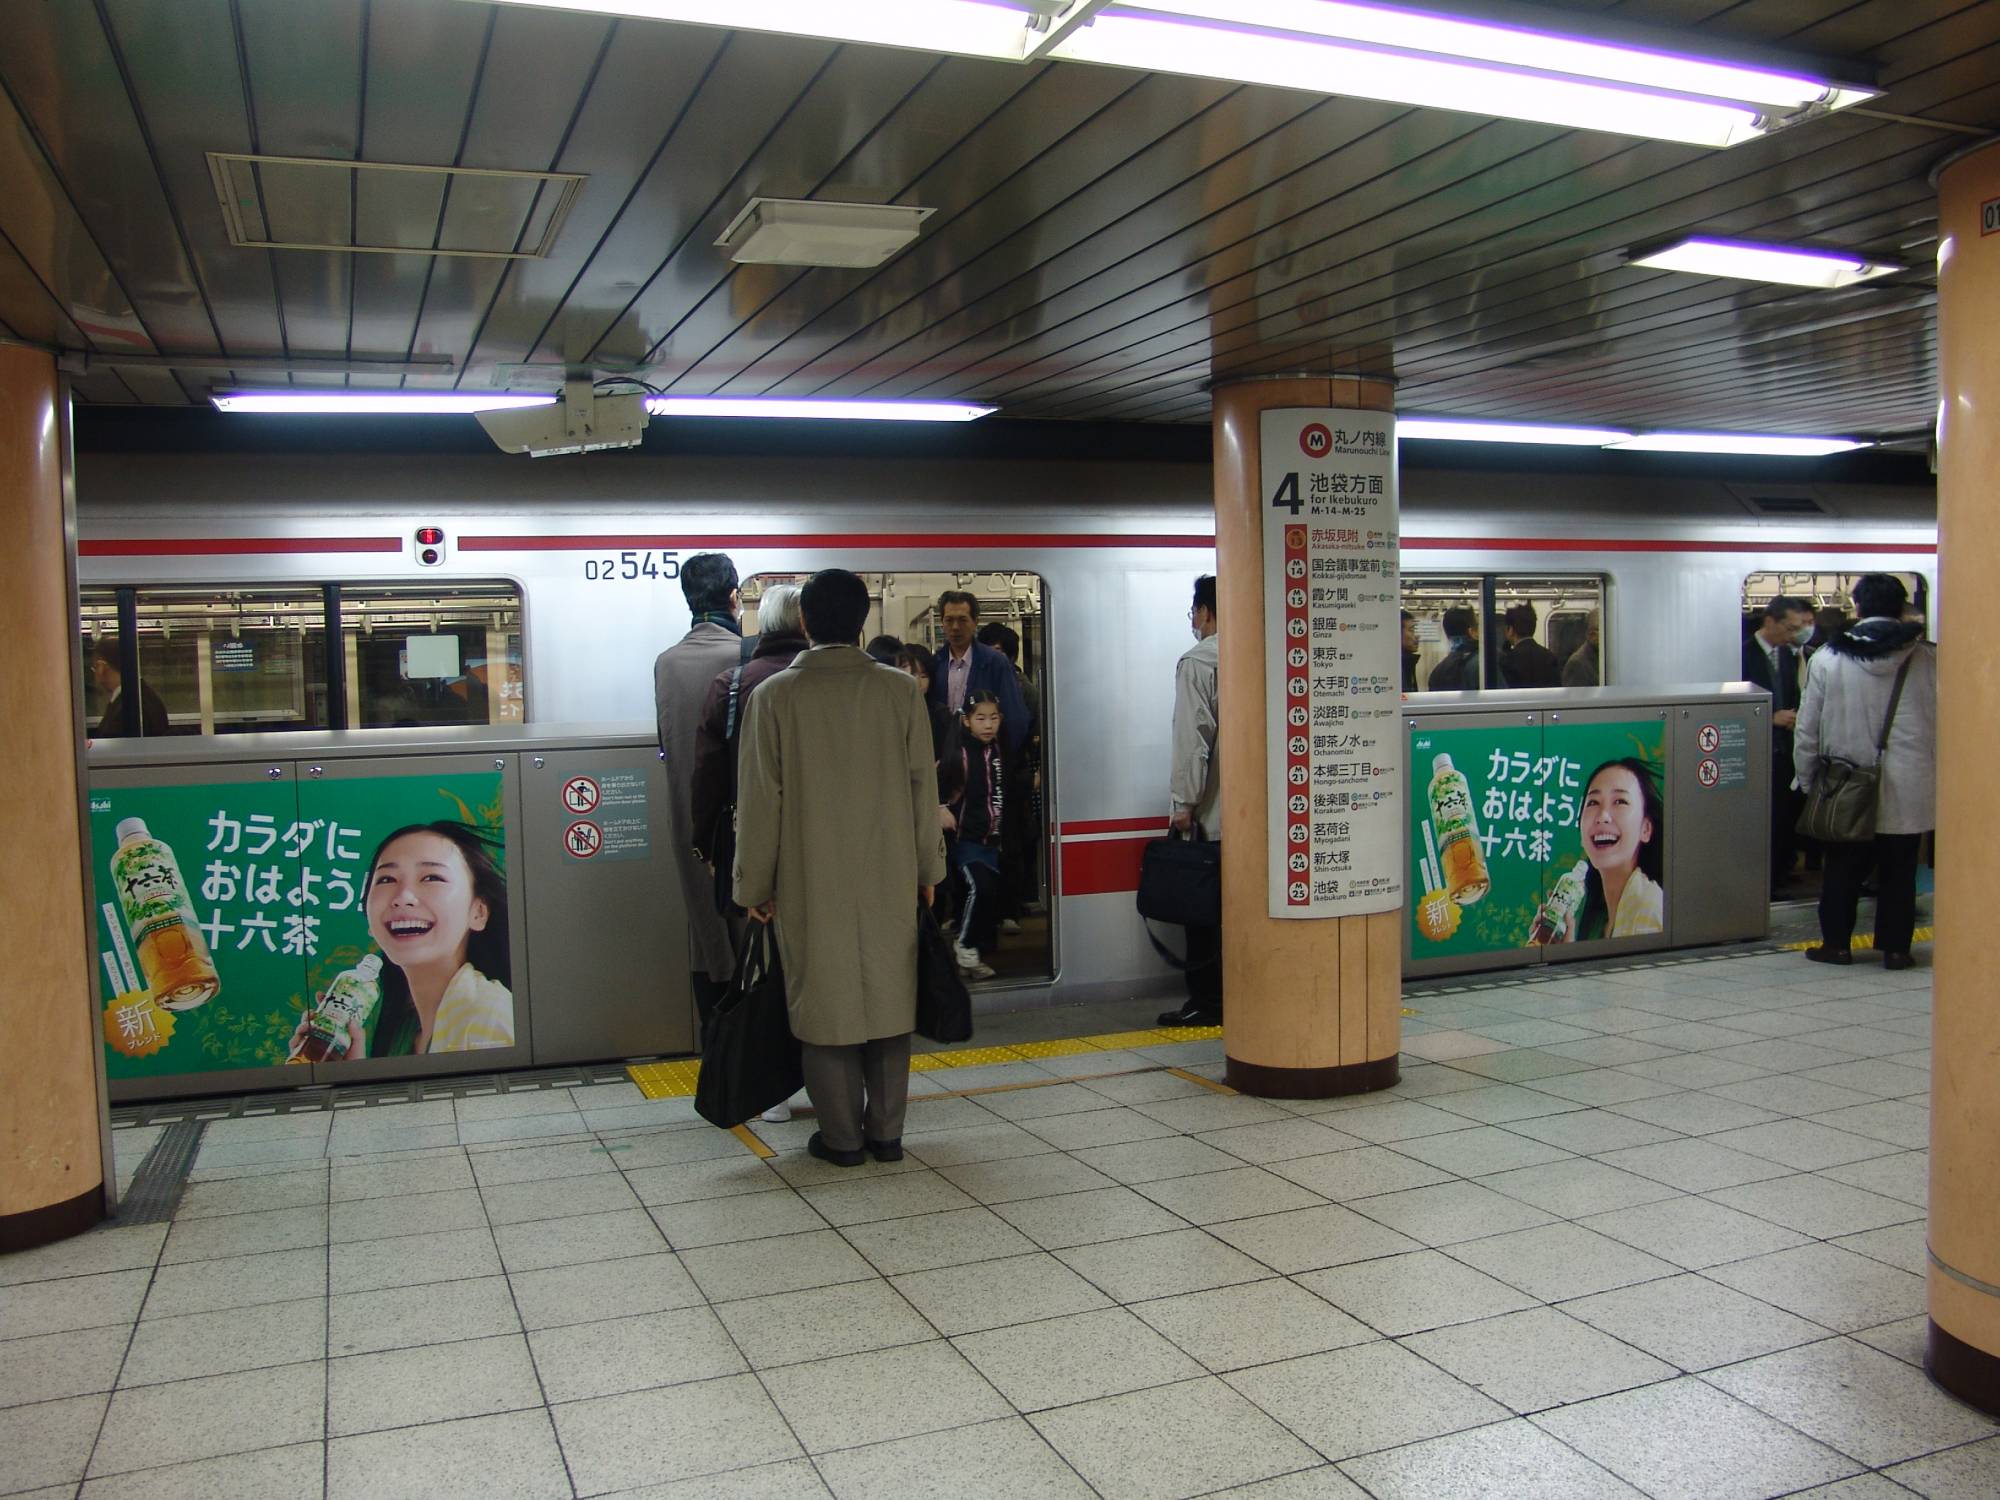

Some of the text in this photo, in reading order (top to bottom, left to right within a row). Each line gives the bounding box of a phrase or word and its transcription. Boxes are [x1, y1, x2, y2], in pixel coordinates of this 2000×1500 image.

[1309, 434, 1324, 447] M
[1335, 429, 1386, 447] 丸ノ内線
[1335, 447, 1390, 457] Marunouchi Line
[1310, 473, 1383, 494] 池袋方面
[1272, 472, 1304, 515] 4
[1311, 495, 1378, 506] for Ikebukuro
[1312, 528, 1359, 543] 赤坂見附
[1312, 543, 1365, 551] Akasaka-mitsuke
[1312, 558, 1380, 572] 国会議事堂前
[1291, 567, 1303, 575] 14
[1312, 573, 1367, 581] Kokkai-gijidomae
[1291, 597, 1303, 605] 15
[1312, 602, 1356, 610] Kasumigaseki
[1312, 617, 1337, 631] 銀座
[1291, 627, 1304, 635] 16
[1313, 647, 1338, 660] 東京
[1292, 656, 1304, 664] 17
[1313, 661, 1333, 669] Tokyo
[1313, 676, 1349, 690] 大手町
[1292, 686, 1304, 694] 18
[1313, 690, 1345, 698] Otemachi
[1313, 705, 1349, 719] 淡路町
[1292, 715, 1305, 723] 19
[1313, 720, 1344, 728] Awajicho
[1313, 734, 1361, 748] 御茶ノ水
[1292, 744, 1305, 752] 20
[1314, 748, 1354, 756] Ochanomizu
[1313, 762, 1371, 777] 本郷三丁目
[1487, 748, 1581, 788] カラダに
[1292, 774, 1304, 782] 21
[1314, 777, 1369, 786] Hongo-sanchome
[1313, 793, 1349, 807] 後楽園
[1292, 803, 1305, 811] 22
[1314, 807, 1346, 815] Korakuen
[1313, 822, 1350, 836] 茗荷谷
[206, 809, 362, 861] カラダに
[1292, 832, 1305, 840] 23
[1314, 836, 1351, 845] Myogadani
[1479, 824, 1553, 862] 十六茶
[1313, 850, 1350, 865] 新大塚
[1292, 861, 1305, 869] 24
[1313, 880, 1339, 894] 池袋
[1292, 890, 1305, 898] 25
[1314, 894, 1347, 902] Ikebukuro
[1425, 896, 1449, 926] 新
[199, 908, 321, 957] 十六茶
[115, 999, 156, 1038] 新
[127, 1032, 161, 1050] ブレンド
